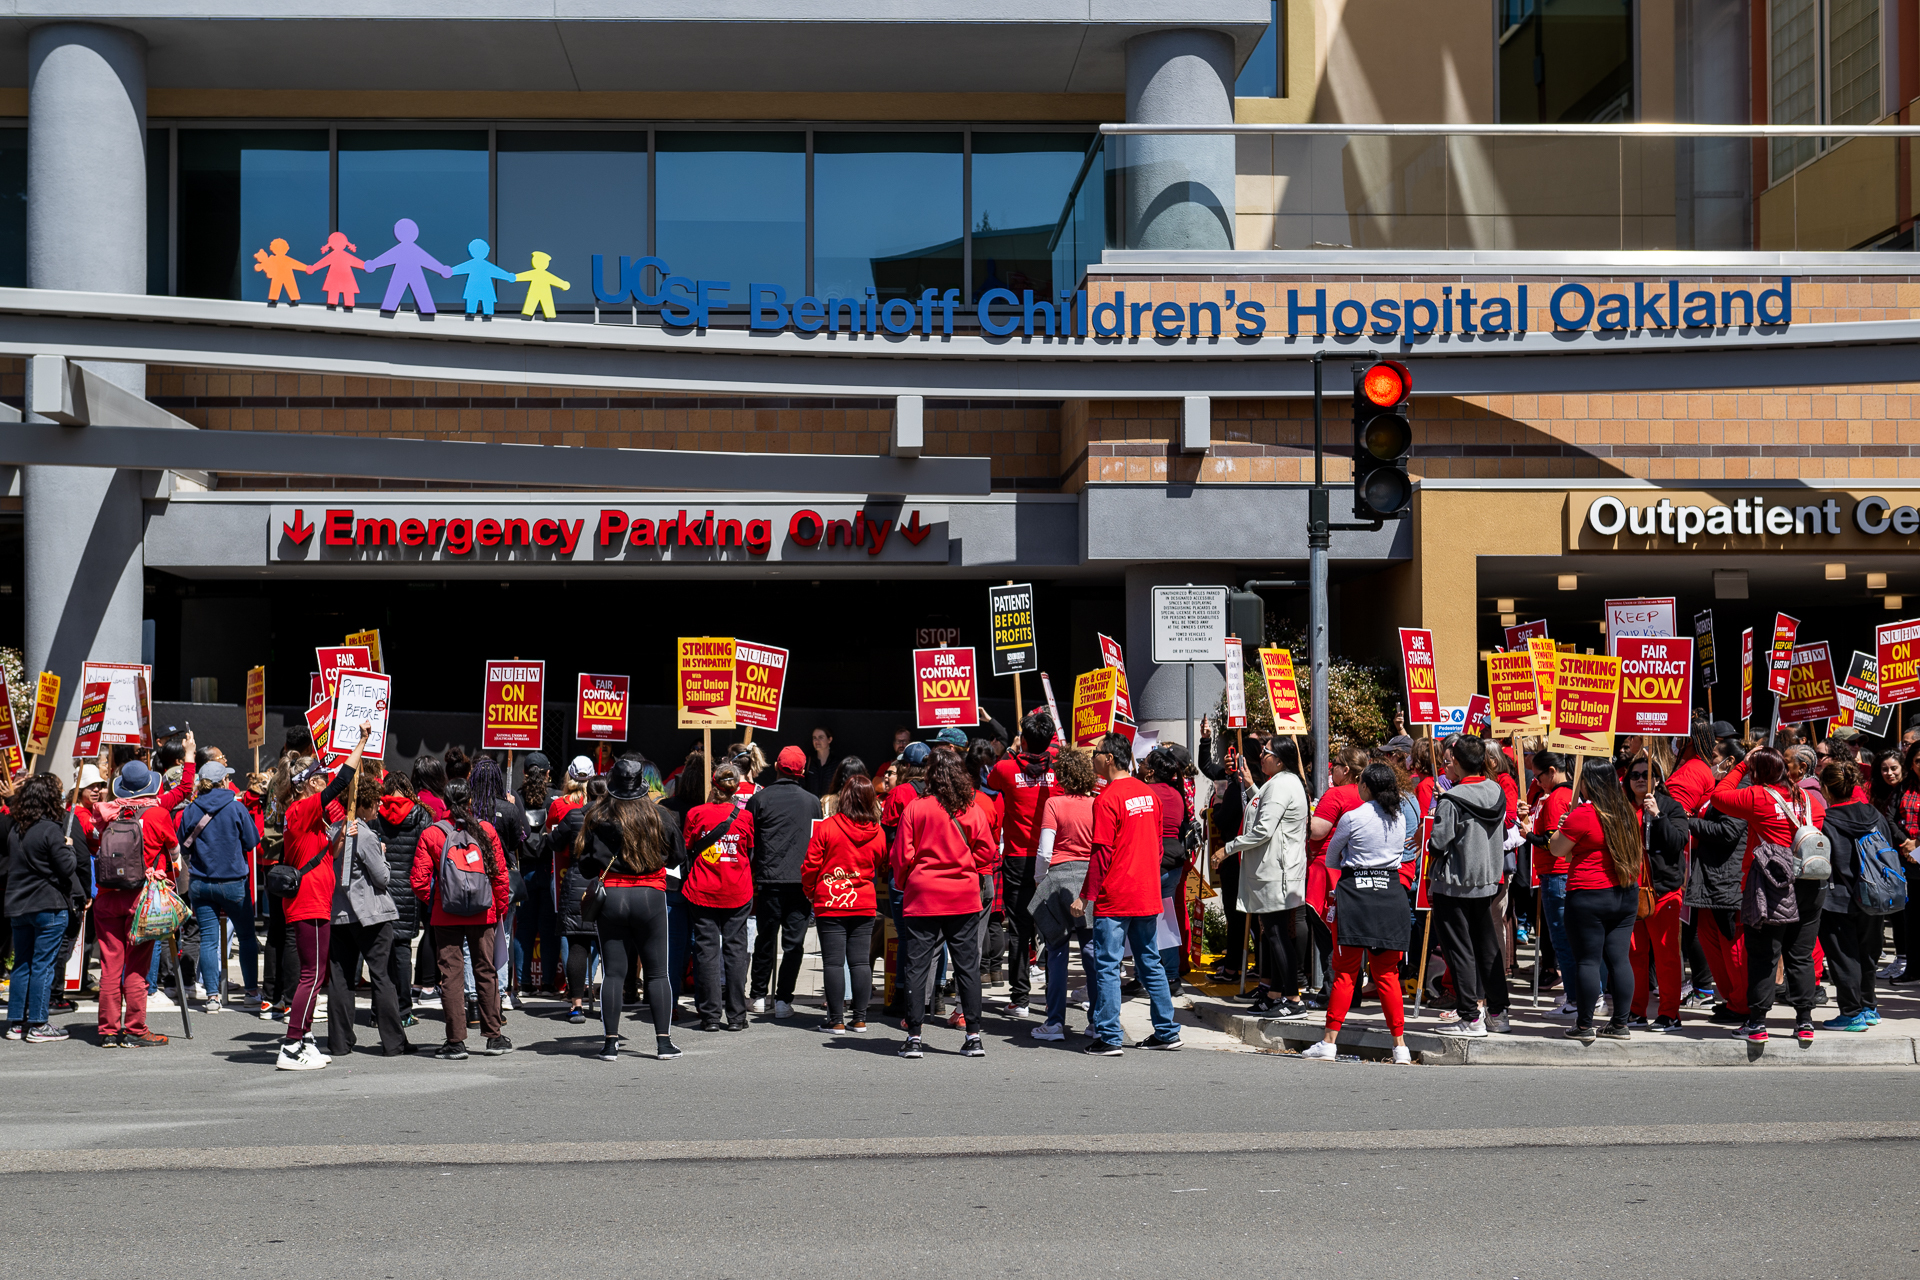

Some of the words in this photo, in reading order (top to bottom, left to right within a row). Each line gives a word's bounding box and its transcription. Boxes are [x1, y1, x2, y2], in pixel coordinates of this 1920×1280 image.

[592, 254, 730, 328] UCSF
[750, 282, 959, 335] Benioff
[978, 288, 1266, 337] Children's
[1288, 284, 1527, 344] Hospital
[1548, 277, 1791, 331] Oakland
[1589, 496, 1841, 543] Outpatient
[325, 509, 585, 555] Emergency
[600, 509, 772, 555] Parking
[788, 509, 890, 555] Only
[994, 593, 1030, 612] PATIENTS
[995, 611, 1031, 628] BEFORE
[1614, 610, 1659, 625] KEEP
[349, 636, 357, 645] RNs
[362, 633, 374, 643] CHEU
[920, 628, 956, 644] STOP
[995, 627, 1032, 643] PROFITS
[1518, 629, 1533, 643] SAFE
[1882, 626, 1920, 643] NUHW
[682, 642, 732, 655] STRIKING
[1412, 636, 1425, 650] SAFE
[1784, 641, 1793, 650] CARE
[737, 648, 783, 666] NUHW
[1108, 643, 1118, 658] FAIR
[1535, 651, 1554, 660] SYMPATHY
[1641, 644, 1667, 658] FAIR
[1892, 642, 1910, 661] ON
[336, 654, 355, 666] FAIR
[682, 658, 690, 668] IN
[692, 658, 732, 668] SYMPATHY
[934, 654, 956, 666] FAIR
[1263, 653, 1291, 666] STRIKING
[1408, 651, 1432, 665] STAFFING
[1491, 655, 1532, 671] STRIKIN
[1537, 661, 1555, 669] STRIKING
[920, 666, 971, 679] CONTRACT
[1267, 668, 1272, 676] IN
[1272, 668, 1292, 677] SYMPATHY
[1560, 658, 1616, 677] STRIKING
[1621, 660, 1686, 674] CONTRACT
[1790, 664, 1814, 682] ON
[492, 669, 539, 680] NUHW
[746, 665, 769, 684] ON
[1079, 677, 1089, 686] RNs
[1096, 671, 1112, 681] CHEU
[1409, 667, 1434, 688] NOW
[1492, 672, 1500, 681] IN
[342, 678, 387, 700] PATIENTS
[596, 680, 613, 689] FAIR
[686, 679, 702, 689] Our
[704, 679, 729, 689] Union
[922, 679, 971, 698] NOW
[1079, 680, 1109, 695] SYMPATHY
[1559, 676, 1568, 686] IN
[1570, 676, 1615, 690] SYMPATHY
[1623, 677, 1684, 698] NOW
[1783, 679, 1832, 700] TRIKE
[501, 684, 524, 702] ON
[583, 689, 625, 700] CONTRACT
[686, 691, 724, 702] Siblings!
[1080, 691, 1106, 704] STRIKING
[1273, 687, 1282, 697] Our
[1282, 688, 1296, 698] Union
[1497, 692, 1512, 702] Our
[82, 707, 92, 716] KEEP
[91, 703, 104, 713] CARE
[584, 700, 623, 716] NOW
[1275, 698, 1296, 710] Siblings!
[1498, 701, 1534, 712] Siblings!
[1561, 699, 1579, 711] Our
[1581, 701, 1609, 714] Union
[344, 704, 380, 720] BEFORE
[488, 704, 538, 722] STRIKE
[1076, 706, 1095, 723] 100%
[1838, 708, 1849, 724] ON
[1081, 715, 1102, 727] PATIENT
[1560, 712, 1602, 727] Siblings!
[79, 725, 89, 736] EAST
[89, 722, 99, 733] BAY
[337, 724, 382, 742] PROTS
[1078, 723, 1107, 737] ADVOCATES
